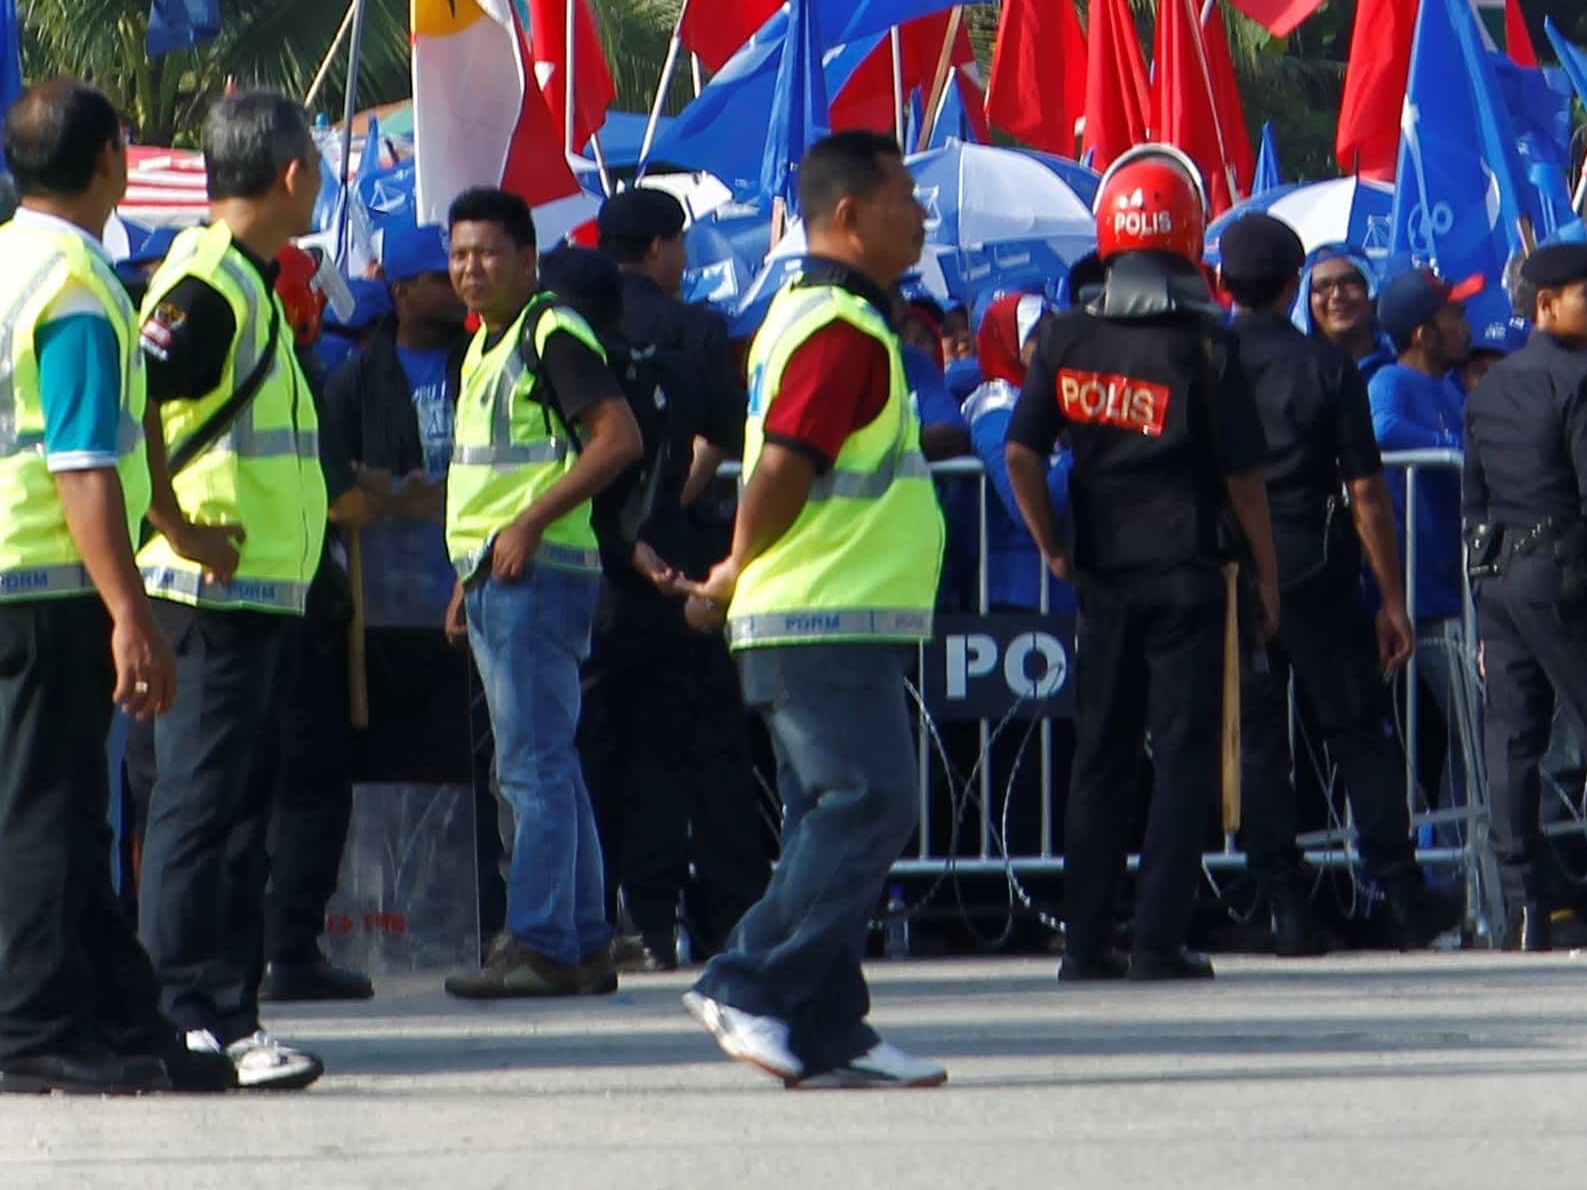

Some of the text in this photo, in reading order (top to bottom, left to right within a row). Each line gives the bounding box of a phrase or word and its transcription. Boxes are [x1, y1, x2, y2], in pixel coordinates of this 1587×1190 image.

[1114, 211, 1172, 236] POLIS
[1060, 377, 1155, 430] POLIS
[946, 631, 1074, 699] PO
